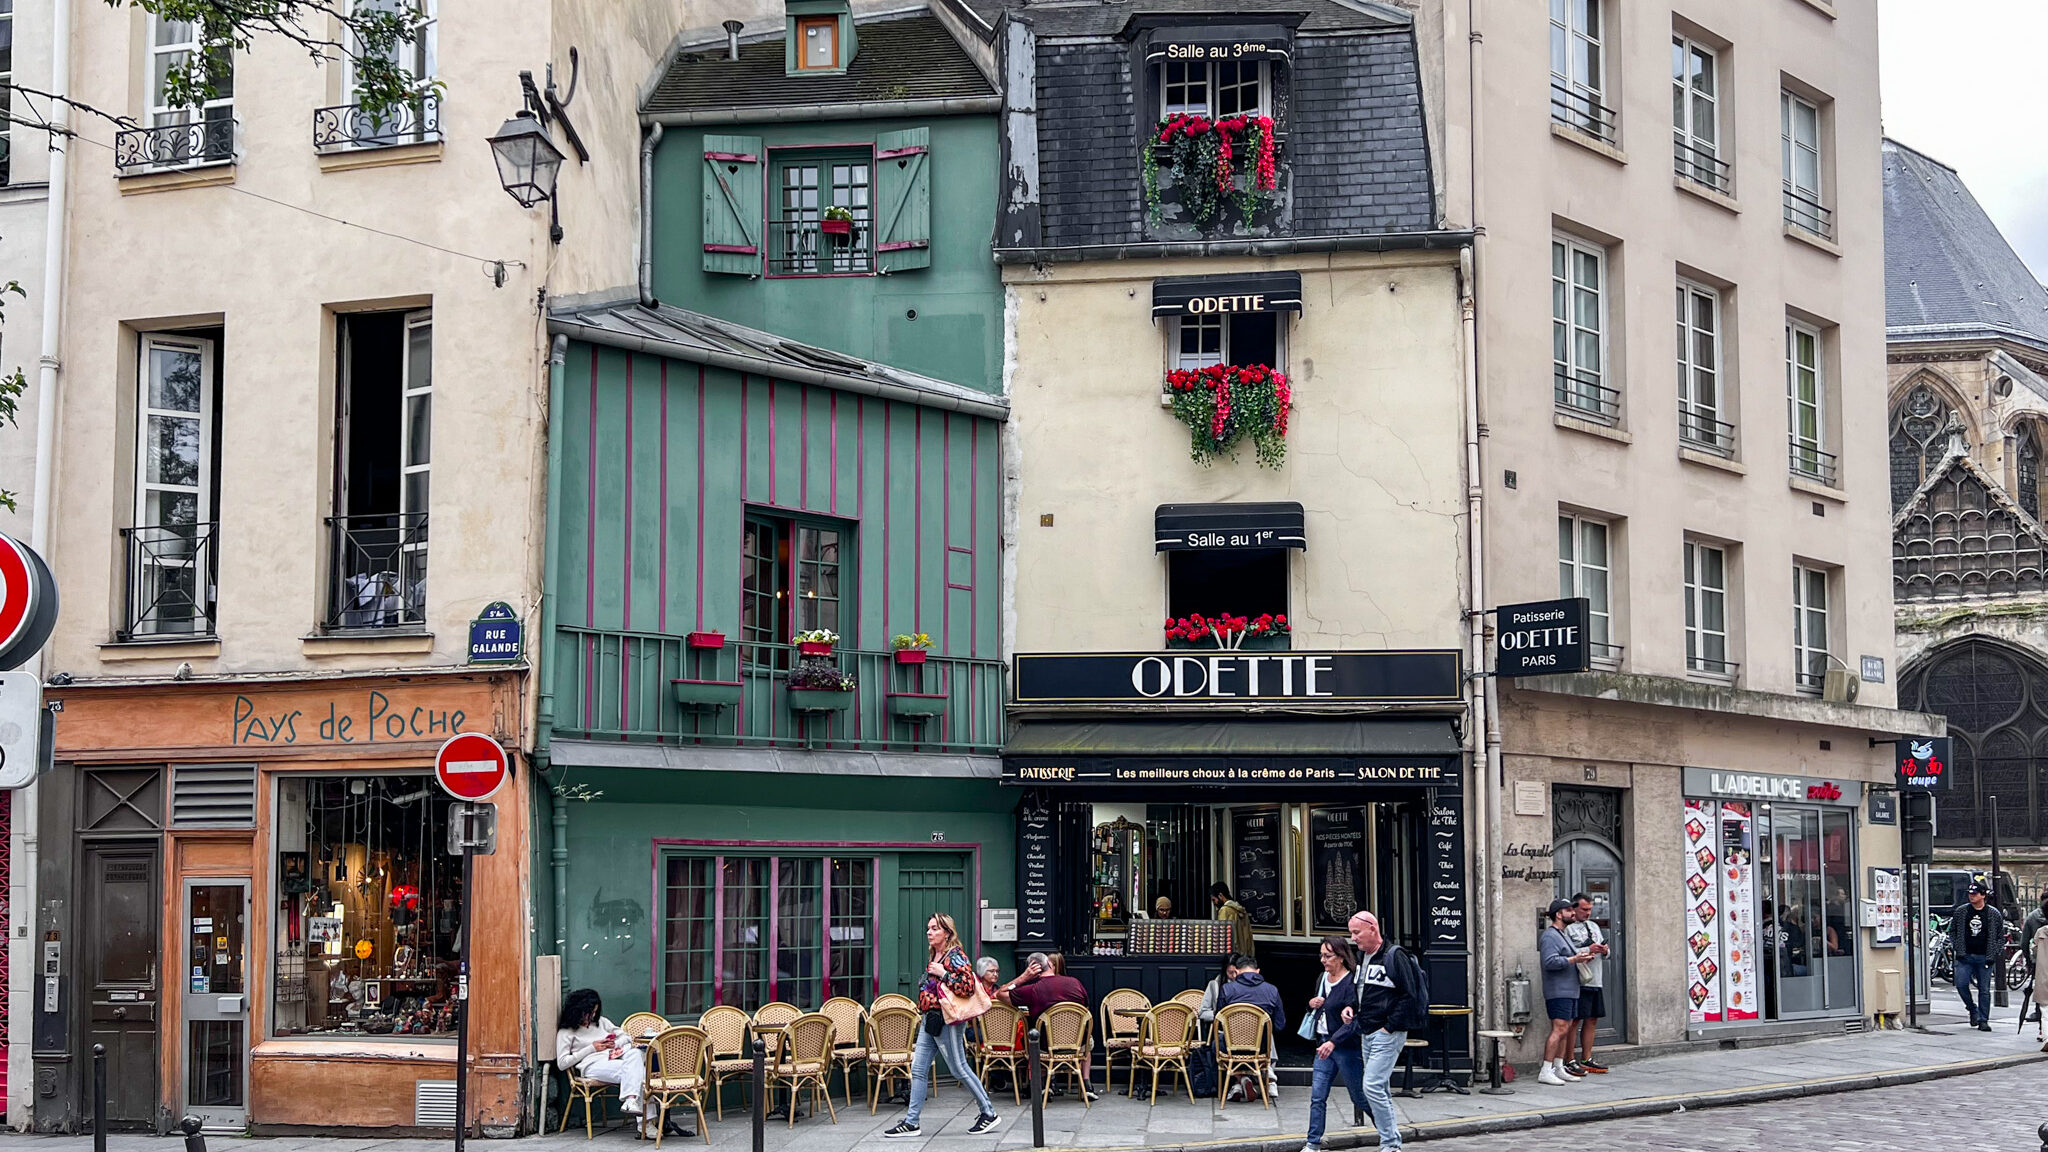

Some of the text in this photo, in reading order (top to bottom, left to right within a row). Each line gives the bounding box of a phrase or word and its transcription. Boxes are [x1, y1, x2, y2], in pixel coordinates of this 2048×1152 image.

[1167, 44, 1204, 58] Salle
[1209, 46, 1228, 58] au
[1187, 295, 1265, 314] ODETTE
[1187, 530, 1274, 547] Salle au 1er
[1513, 609, 1565, 624] Patisserie
[485, 629, 507, 640] RUE
[1500, 626, 1578, 651] ODETTE
[472, 642, 518, 653] GALANDE
[1522, 654, 1557, 667] PARIS
[1131, 656, 1334, 698] ODETTE
[48, 701, 62, 711] 73
[319, 702, 354, 743] de
[1019, 767, 1076, 781] PATISSERIE
[1116, 768, 1137, 778] Les
[1138, 768, 1190, 779] meilleurs
[1192, 768, 1226, 779] choux
[1227, 768, 1235, 778] à
[1238, 768, 1249, 778] la
[1289, 768, 1303, 779] de
[1305, 768, 1335, 779] Paris
[1357, 767, 1397, 780] SALON
[1399, 767, 1414, 779] DE
[1586, 768, 1596, 779] 79
[1907, 776, 1938, 788] soupe
[1433, 806, 1456, 816] Salon
[1431, 816, 1457, 826] de Thé
[932, 832, 944, 841] 75
[1438, 841, 1452, 851] Café
[1520, 843, 1555, 860] Coquille
[1502, 865, 1560, 882] Saint Jacques
[1433, 881, 1460, 889] Chocolat
[1431, 906, 1462, 916] Salle au
[1441, 917, 1461, 928] étage
